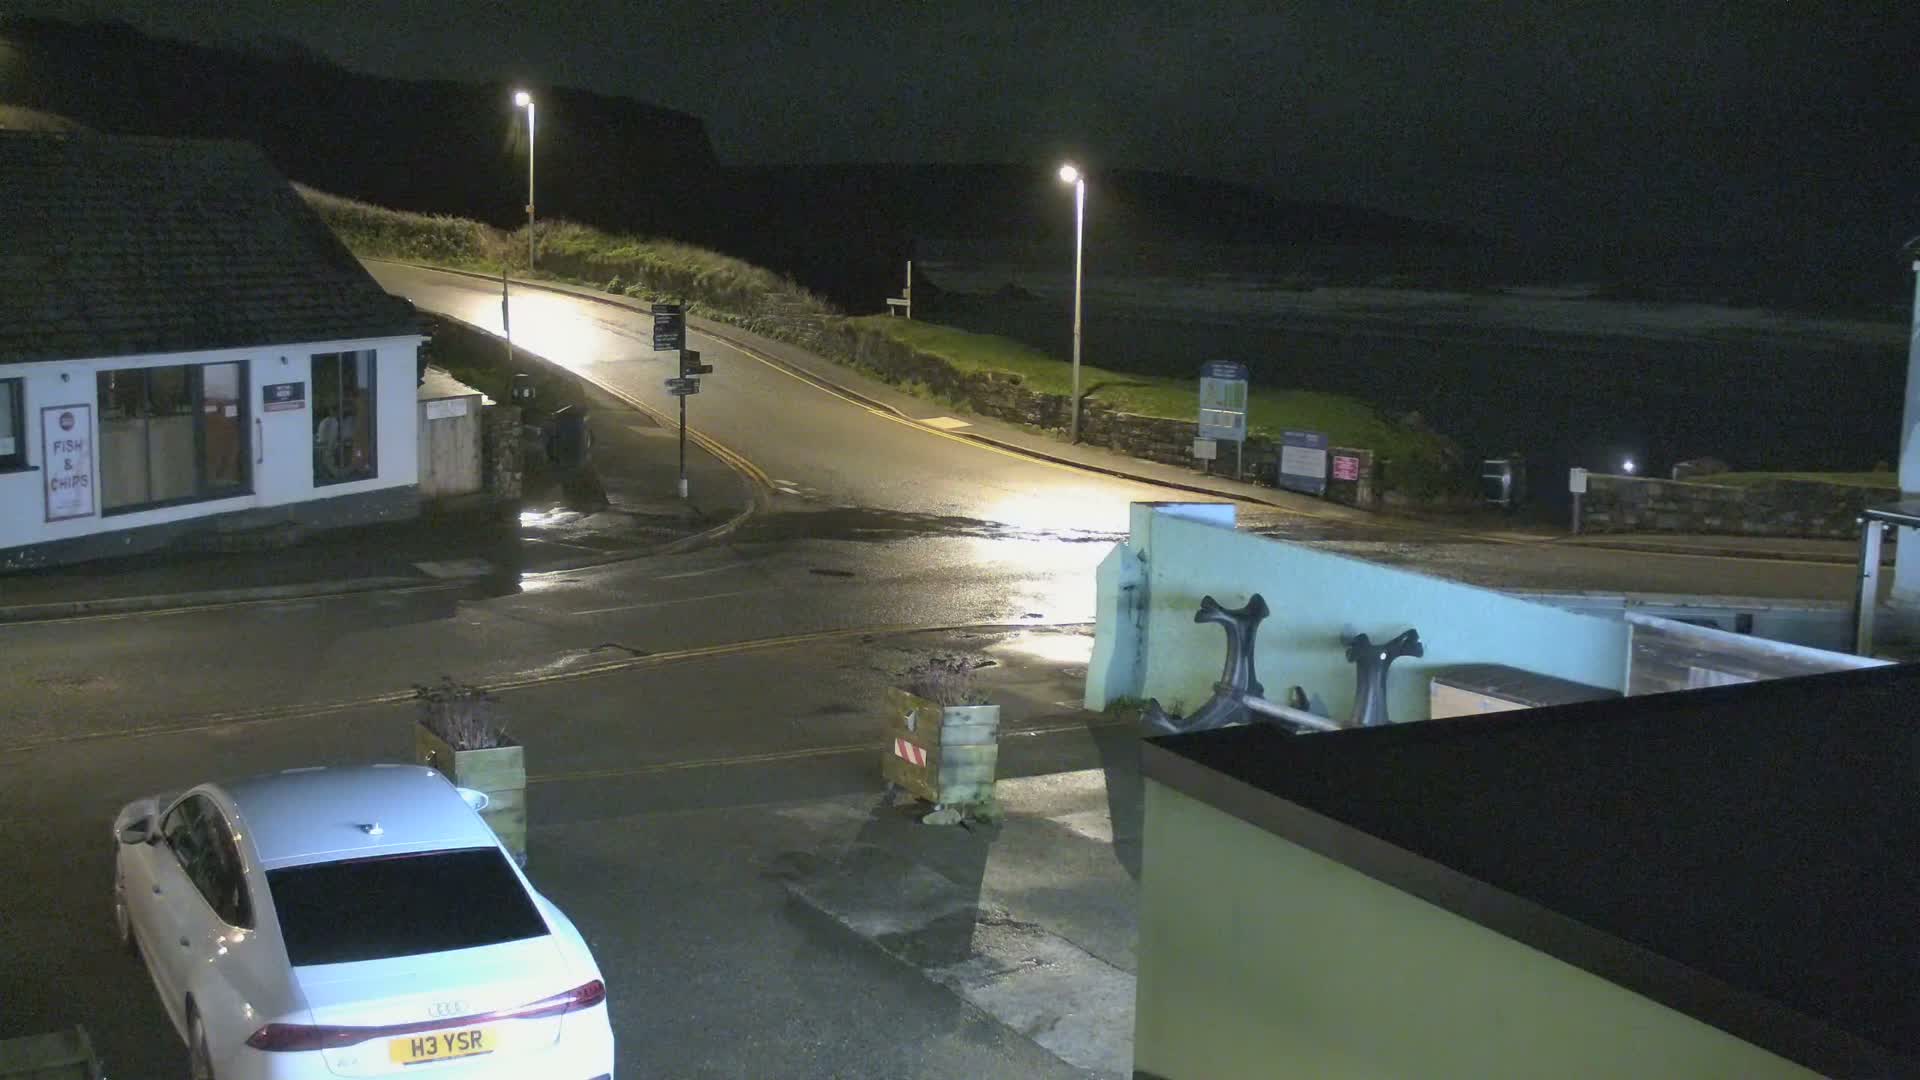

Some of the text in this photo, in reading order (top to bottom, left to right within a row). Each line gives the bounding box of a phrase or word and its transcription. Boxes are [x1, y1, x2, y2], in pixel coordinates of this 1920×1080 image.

[54, 440, 82, 456] FISH
[64, 459, 72, 471] &
[51, 474, 88, 491] CHIPS
[411, 1030, 482, 1057] H3 YSR
